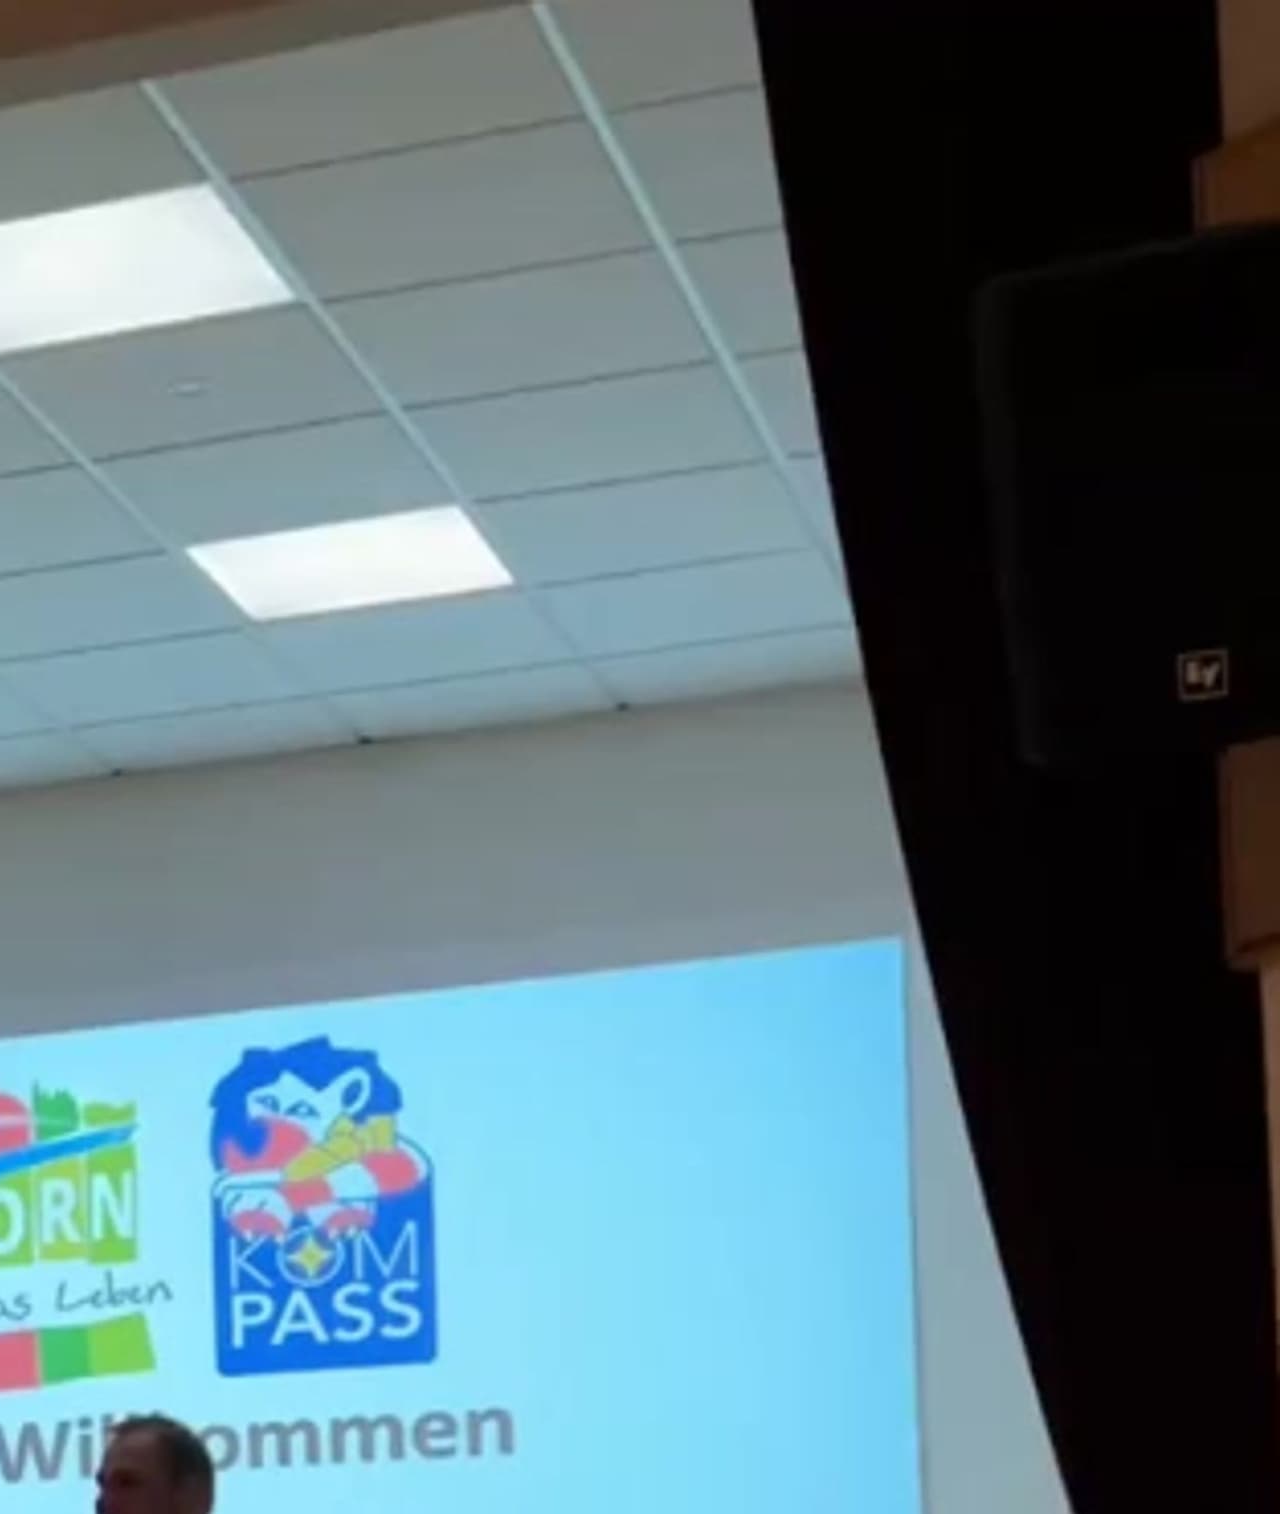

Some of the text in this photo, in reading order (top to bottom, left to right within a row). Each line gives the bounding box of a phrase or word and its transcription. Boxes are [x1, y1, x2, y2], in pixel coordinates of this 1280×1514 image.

[229, 1219, 419, 1289] KOM
[54, 1270, 174, 1314] Leben
[231, 1279, 423, 1350] PASS
